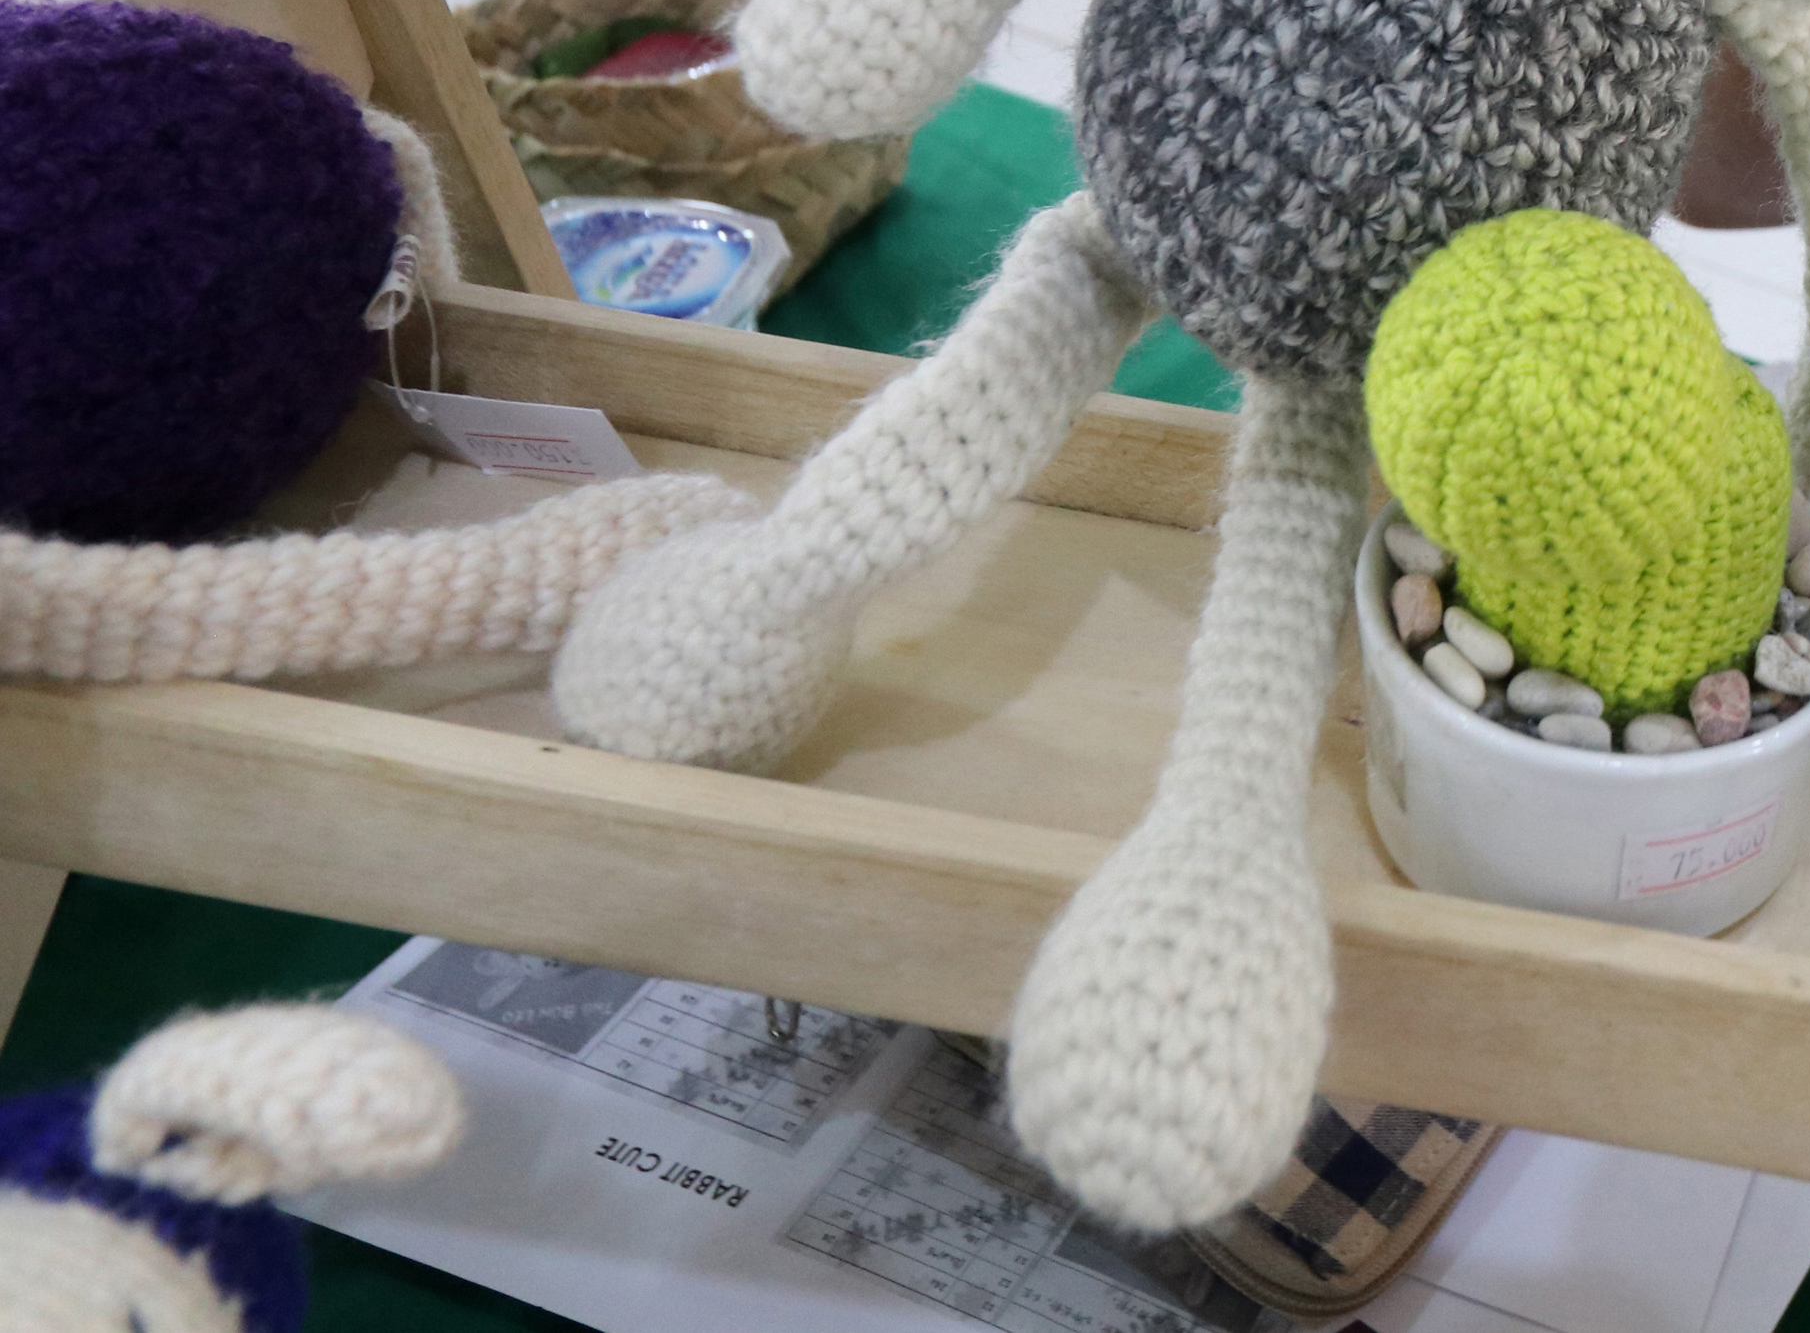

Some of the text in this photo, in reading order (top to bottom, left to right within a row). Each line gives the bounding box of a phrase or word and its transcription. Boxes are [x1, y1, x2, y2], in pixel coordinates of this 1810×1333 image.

[1668, 821, 1767, 881] 75.000
[594, 1137, 750, 1208] RABBIT CUTE
